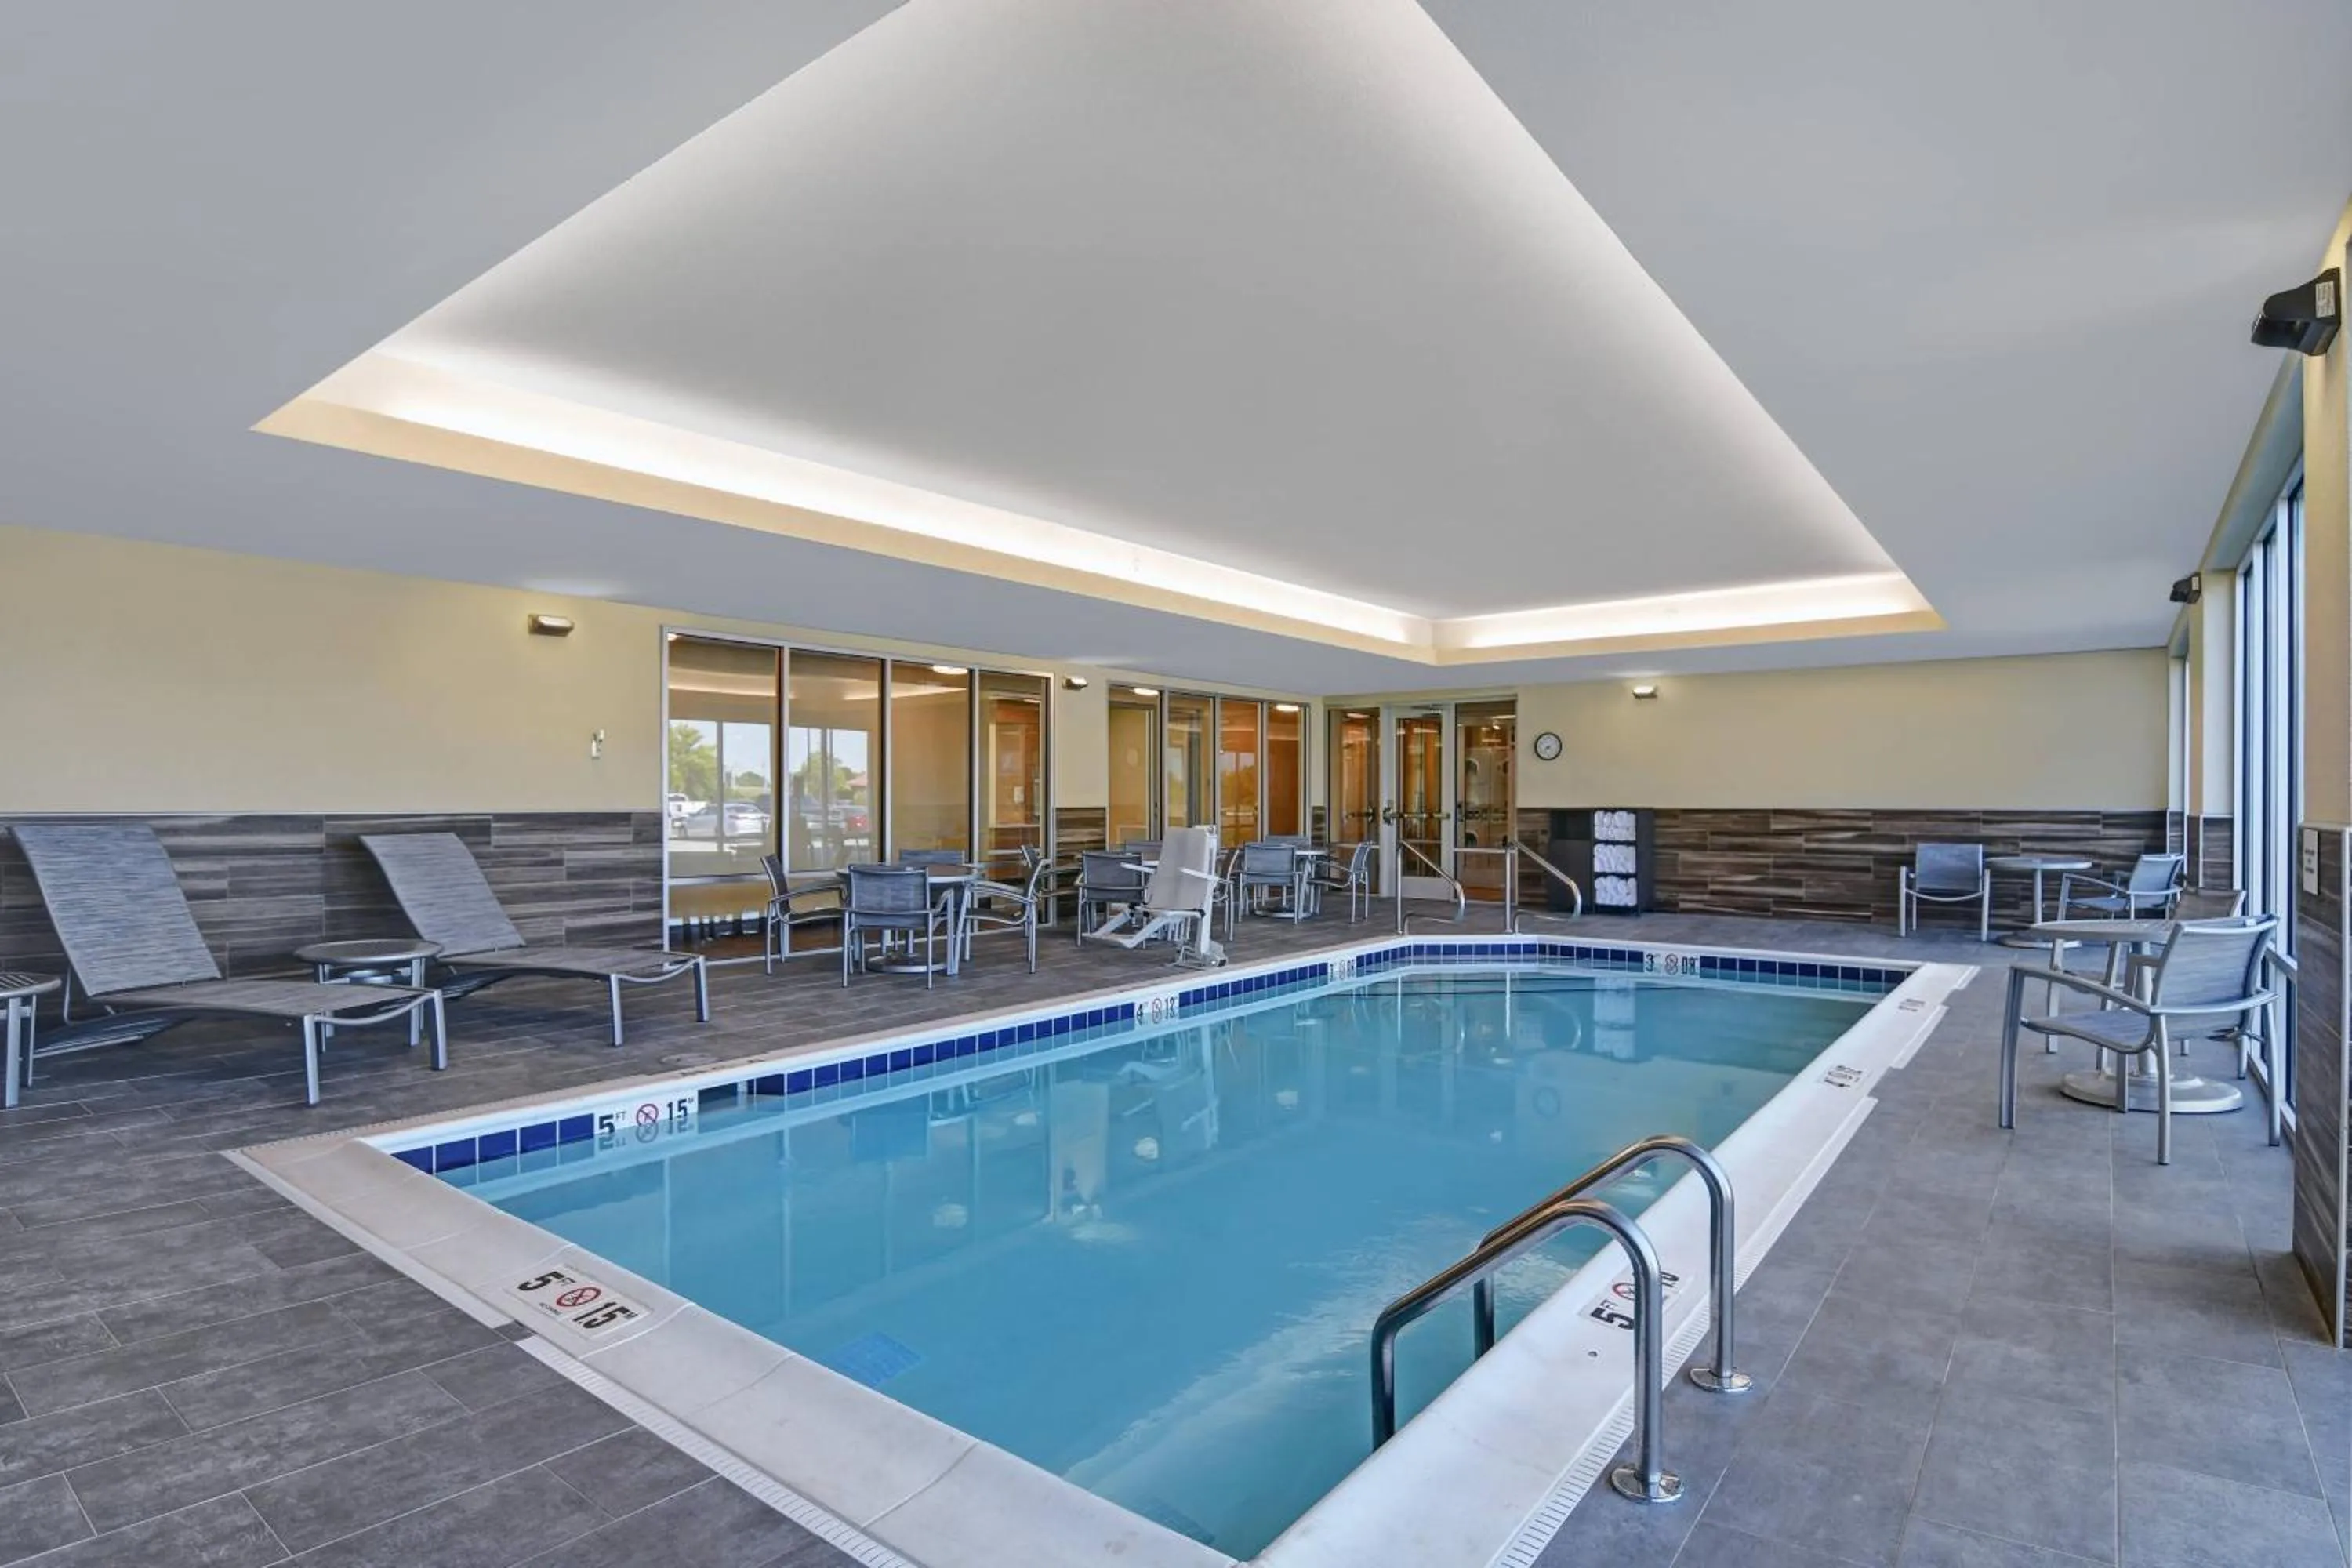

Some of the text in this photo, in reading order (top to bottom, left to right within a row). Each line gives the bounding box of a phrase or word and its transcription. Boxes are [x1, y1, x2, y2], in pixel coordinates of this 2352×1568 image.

[598, 1114, 615, 1134] 5
[517, 1271, 565, 1291] 5
[1590, 1307, 1635, 1330] 5
